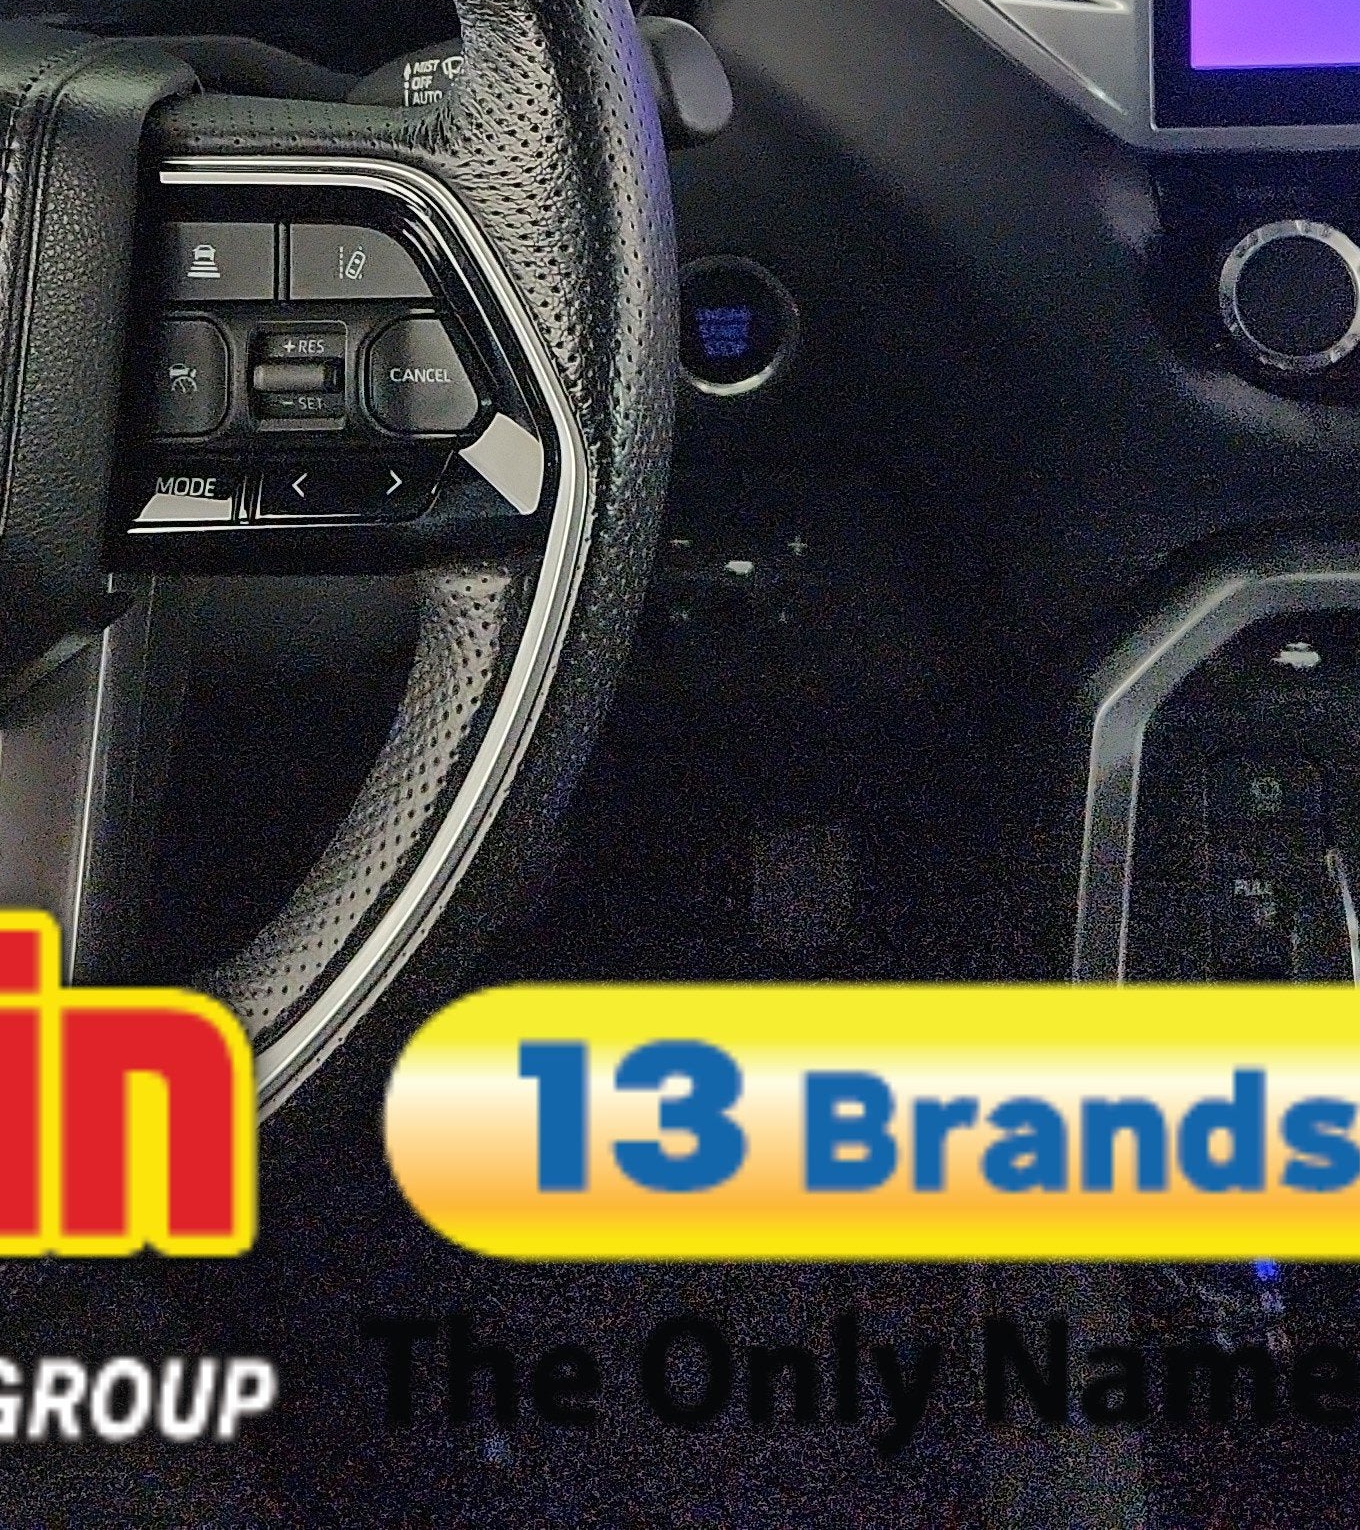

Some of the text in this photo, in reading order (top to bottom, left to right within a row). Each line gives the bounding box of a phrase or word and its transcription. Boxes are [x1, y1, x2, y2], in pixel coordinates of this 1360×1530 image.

[413, 59, 440, 74] MIST
[411, 75, 433, 90] OFF
[412, 90, 442, 105] AUTO
[390, 367, 452, 383] CANCEL
[155, 476, 218, 497] MODE
